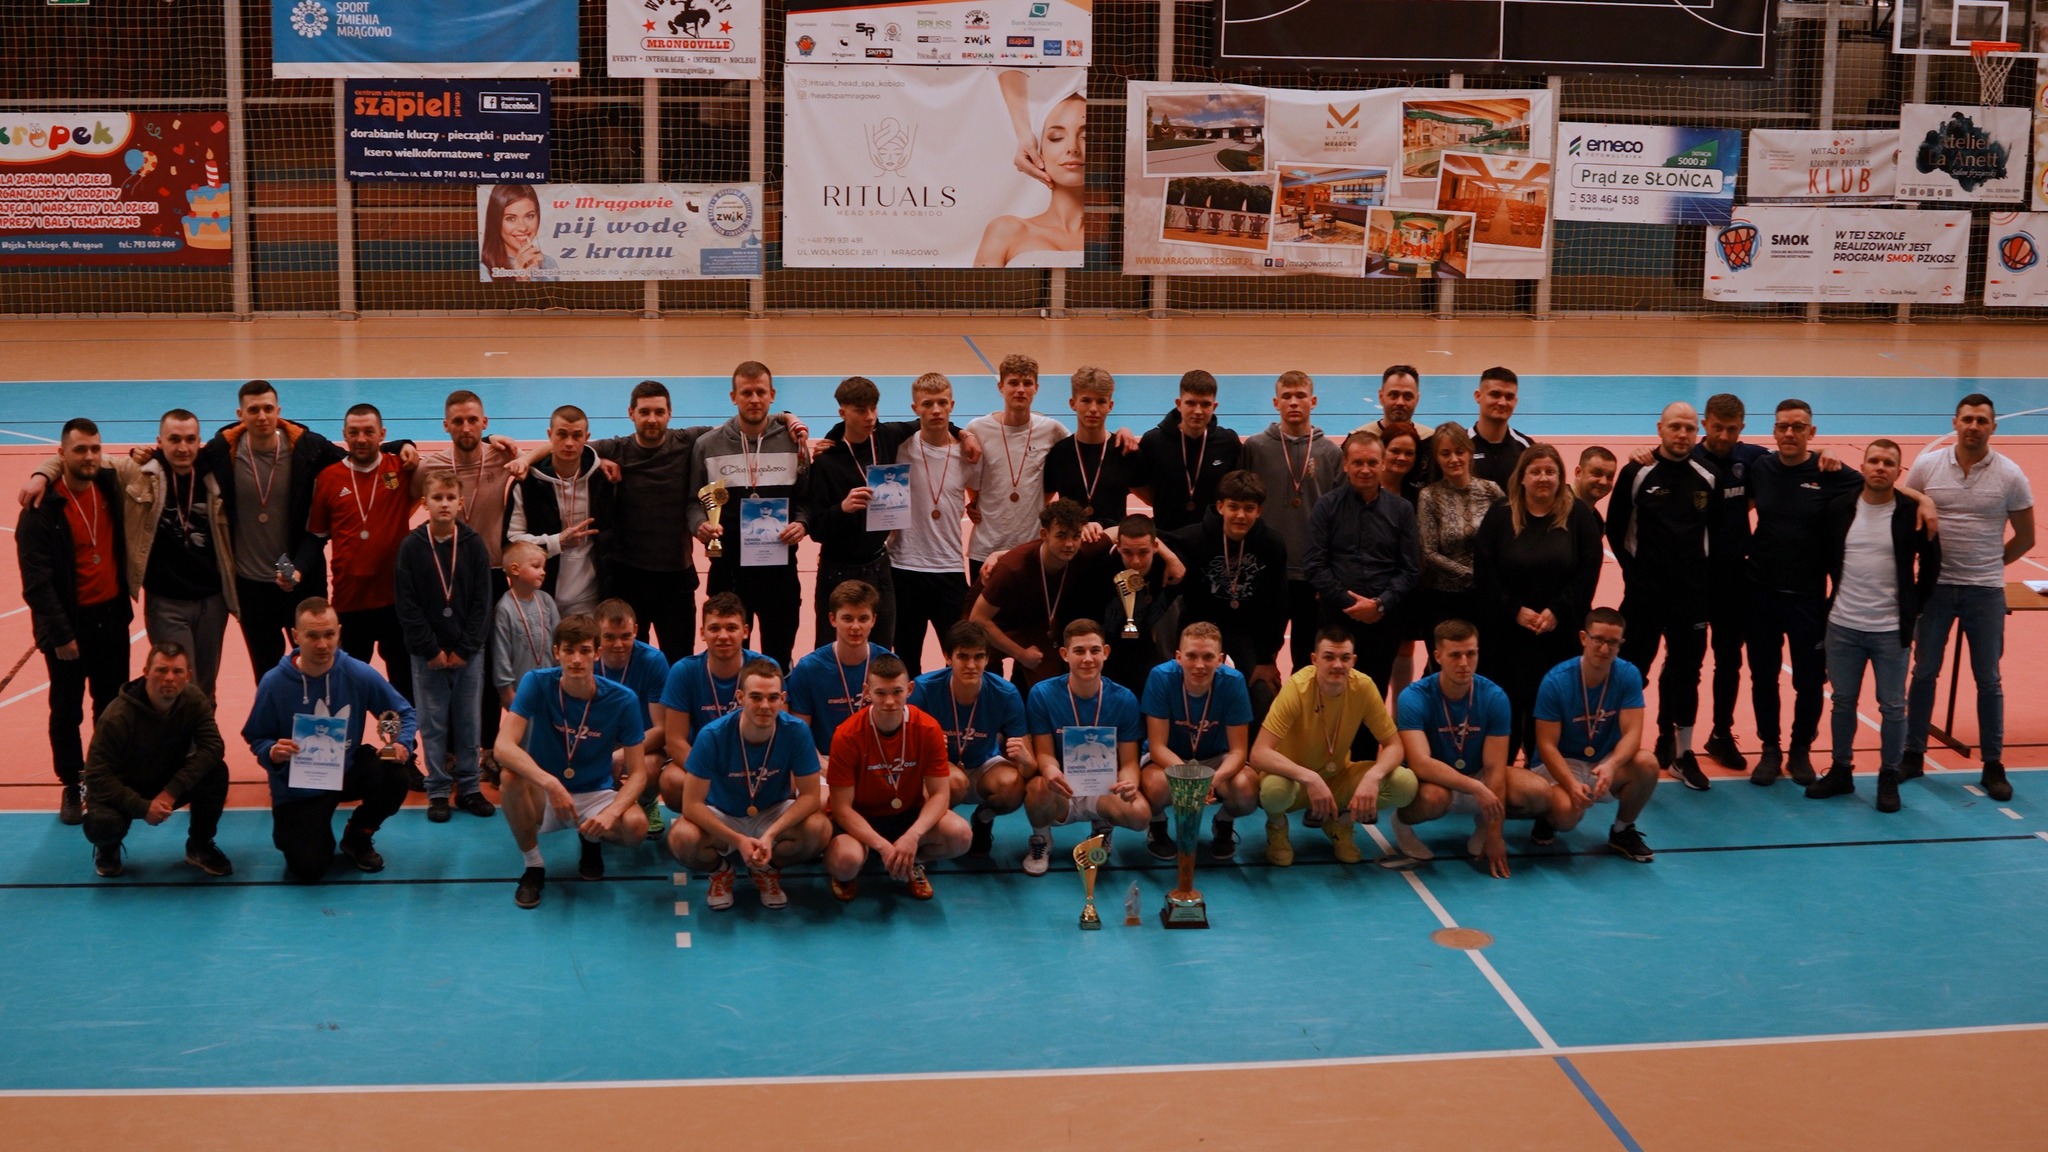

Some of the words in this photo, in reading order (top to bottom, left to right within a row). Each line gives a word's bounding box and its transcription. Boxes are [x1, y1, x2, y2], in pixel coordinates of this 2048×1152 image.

[336, 2, 370, 13] SPORT
[336, 14, 380, 25] ZMIENIA
[337, 26, 392, 39] MRĄGOWO
[646, 39, 730, 49] MRONGOVILLE
[612, 55, 637, 63] EVENTY
[693, 56, 721, 64] IMPREZY
[354, 92, 450, 122] szapiel
[454, 91, 462, 117] com.pl
[350, 129, 404, 139] dorabianie
[406, 129, 439, 142] kluczy
[448, 130, 494, 142] pieczątki
[502, 132, 544, 144] puchary
[1940, 133, 1991, 149] Atelier
[1586, 138, 1644, 154] emeco
[364, 147, 392, 157] ksero
[393, 147, 483, 159] wielkoformatowe
[493, 151, 530, 161] grawer
[1928, 149, 1946, 165] La
[1952, 150, 1999, 167] Anett
[1678, 157, 1699, 165] 5000
[1700, 157, 1708, 166] zł
[16, 173, 53, 186] ZABAW
[55, 173, 77, 186] DLA
[78, 173, 112, 186] DZIECI
[1581, 169, 1617, 187] Prąd
[1622, 173, 1639, 184] ze
[1644, 169, 1714, 188] SŁOŃCA
[69, 188, 121, 200] URODZINY
[823, 185, 957, 208] RITUALS
[1579, 193, 1598, 203] 538
[1600, 194, 1618, 204] 464
[1621, 195, 1640, 205] 538
[34, 202, 39, 214] I
[41, 202, 101, 214] WARSZTATY
[102, 202, 124, 214] DLA
[125, 202, 159, 214] DZIECI
[553, 200, 571, 209] w
[575, 196, 674, 212] Mrągowie
[37, 217, 42, 228] I
[43, 217, 71, 228] BALE
[72, 217, 141, 228] TEMATYCZNE
[552, 216, 597, 239] pij
[606, 217, 690, 238] wodę
[1771, 234, 1809, 246] SMOK
[1835, 230, 1847, 240] W
[1849, 231, 1866, 240] TEJ
[1867, 231, 1906, 240] SZKOLE
[560, 246, 579, 259] z
[586, 243, 676, 259] kranu
[1833, 242, 1907, 251] REALIZOWANY
[1908, 243, 1932, 251] JEST
[891, 249, 939, 258] MRĄGOWO
[1833, 253, 1884, 262] PROGRAM
[1886, 254, 1915, 263] SMOK
[1917, 254, 1956, 263] PZKOSZ
[1135, 256, 1255, 266] WWW.MRAGOWORESORT.PL
[532, 268, 581, 277] bezpieczna
[583, 268, 606, 276] woda
[891, 757, 905, 772] 2
